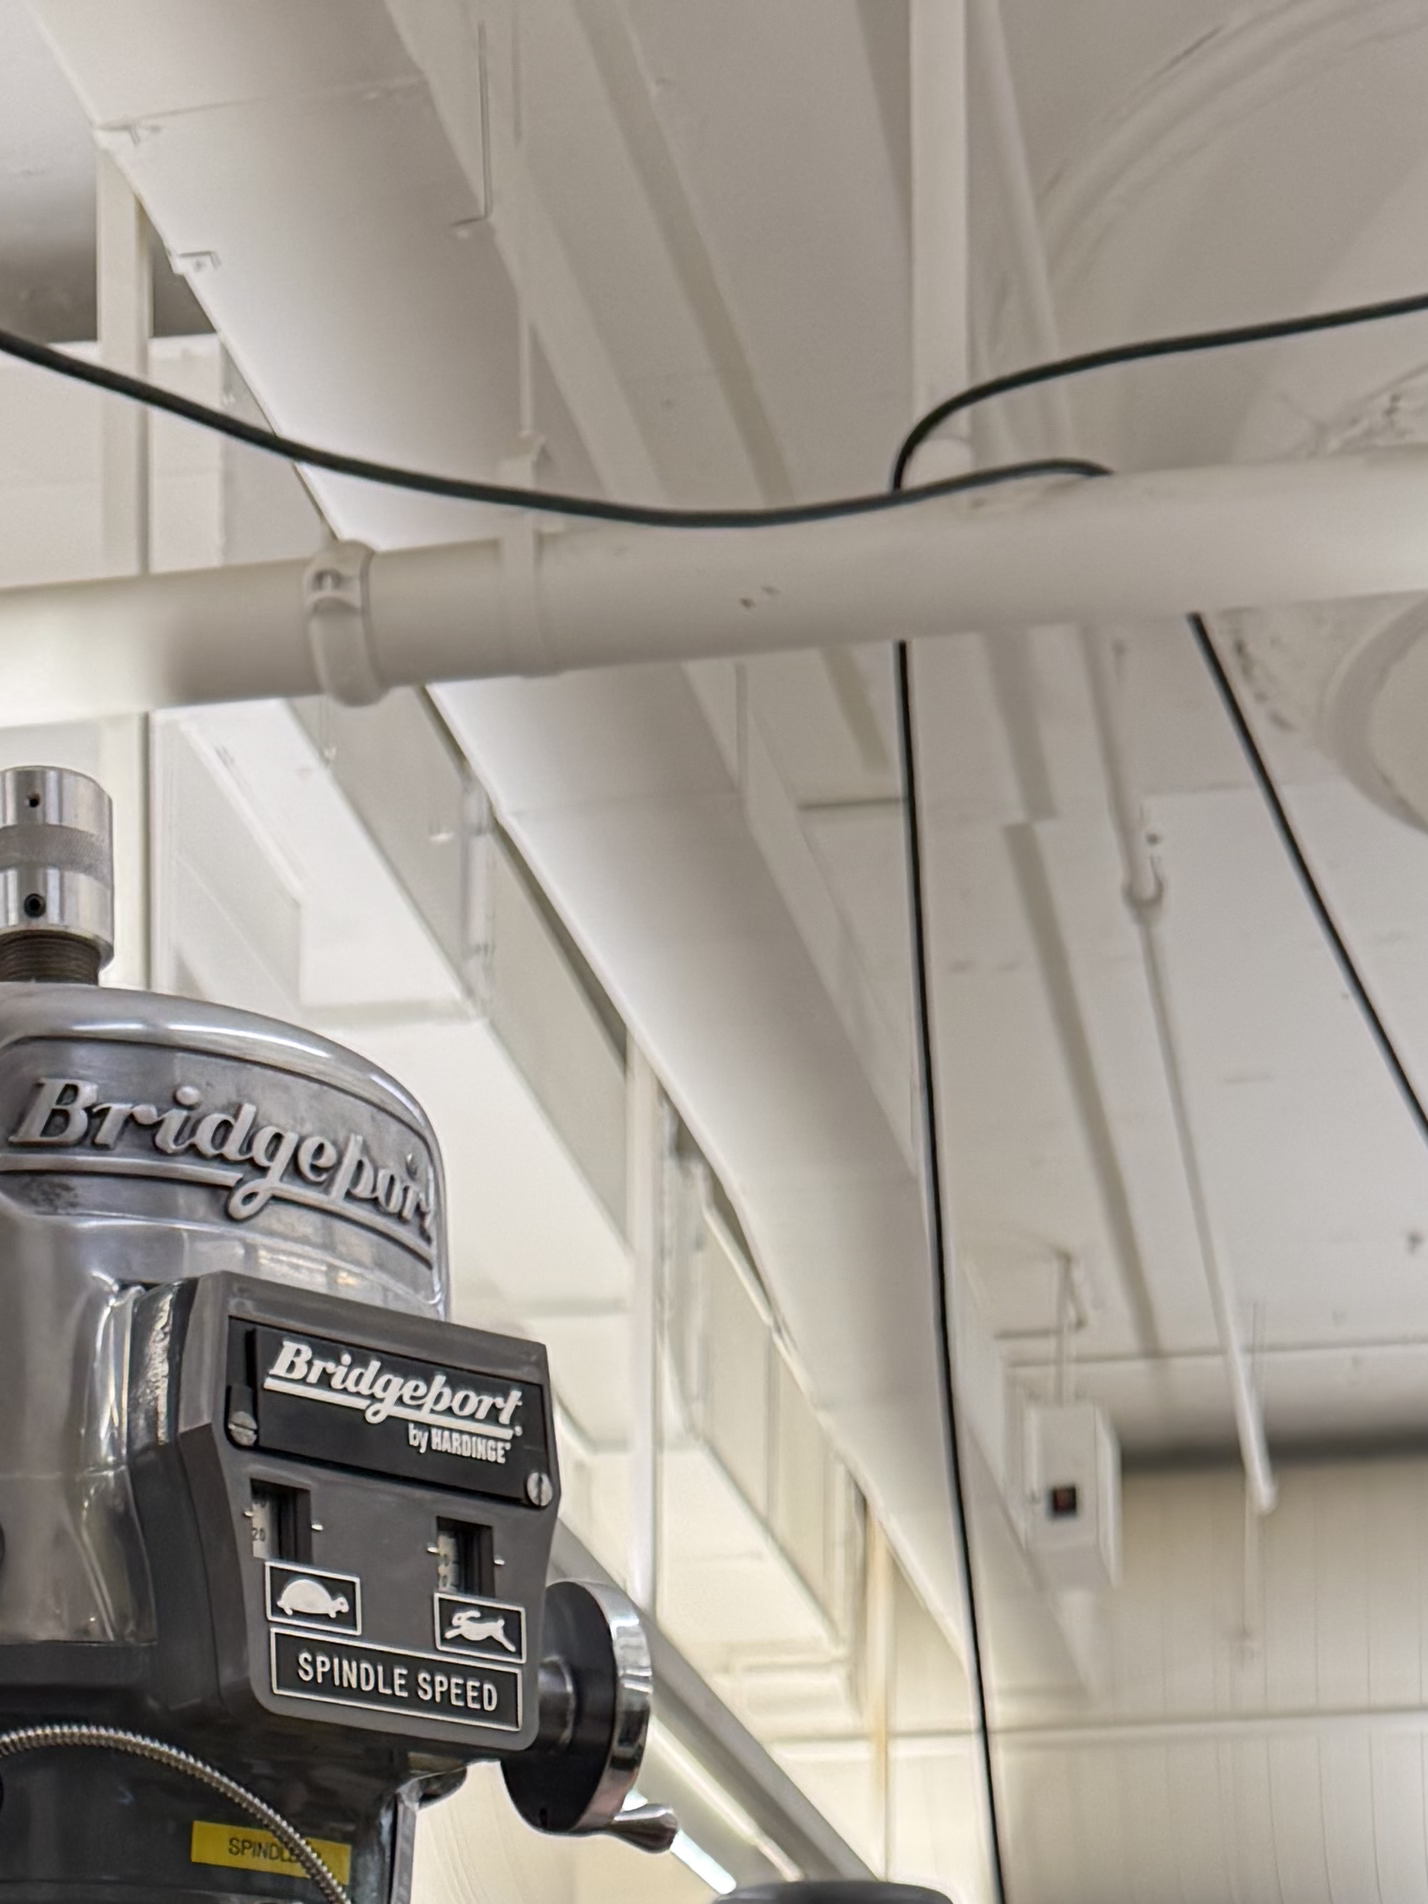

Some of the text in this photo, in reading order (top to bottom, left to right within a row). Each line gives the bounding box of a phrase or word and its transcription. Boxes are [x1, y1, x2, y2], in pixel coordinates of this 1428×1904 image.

[265, 1340, 523, 1430] Bridgeport
[408, 1422, 429, 1454] by
[297, 1651, 499, 1713] SPINDLE SPEED
